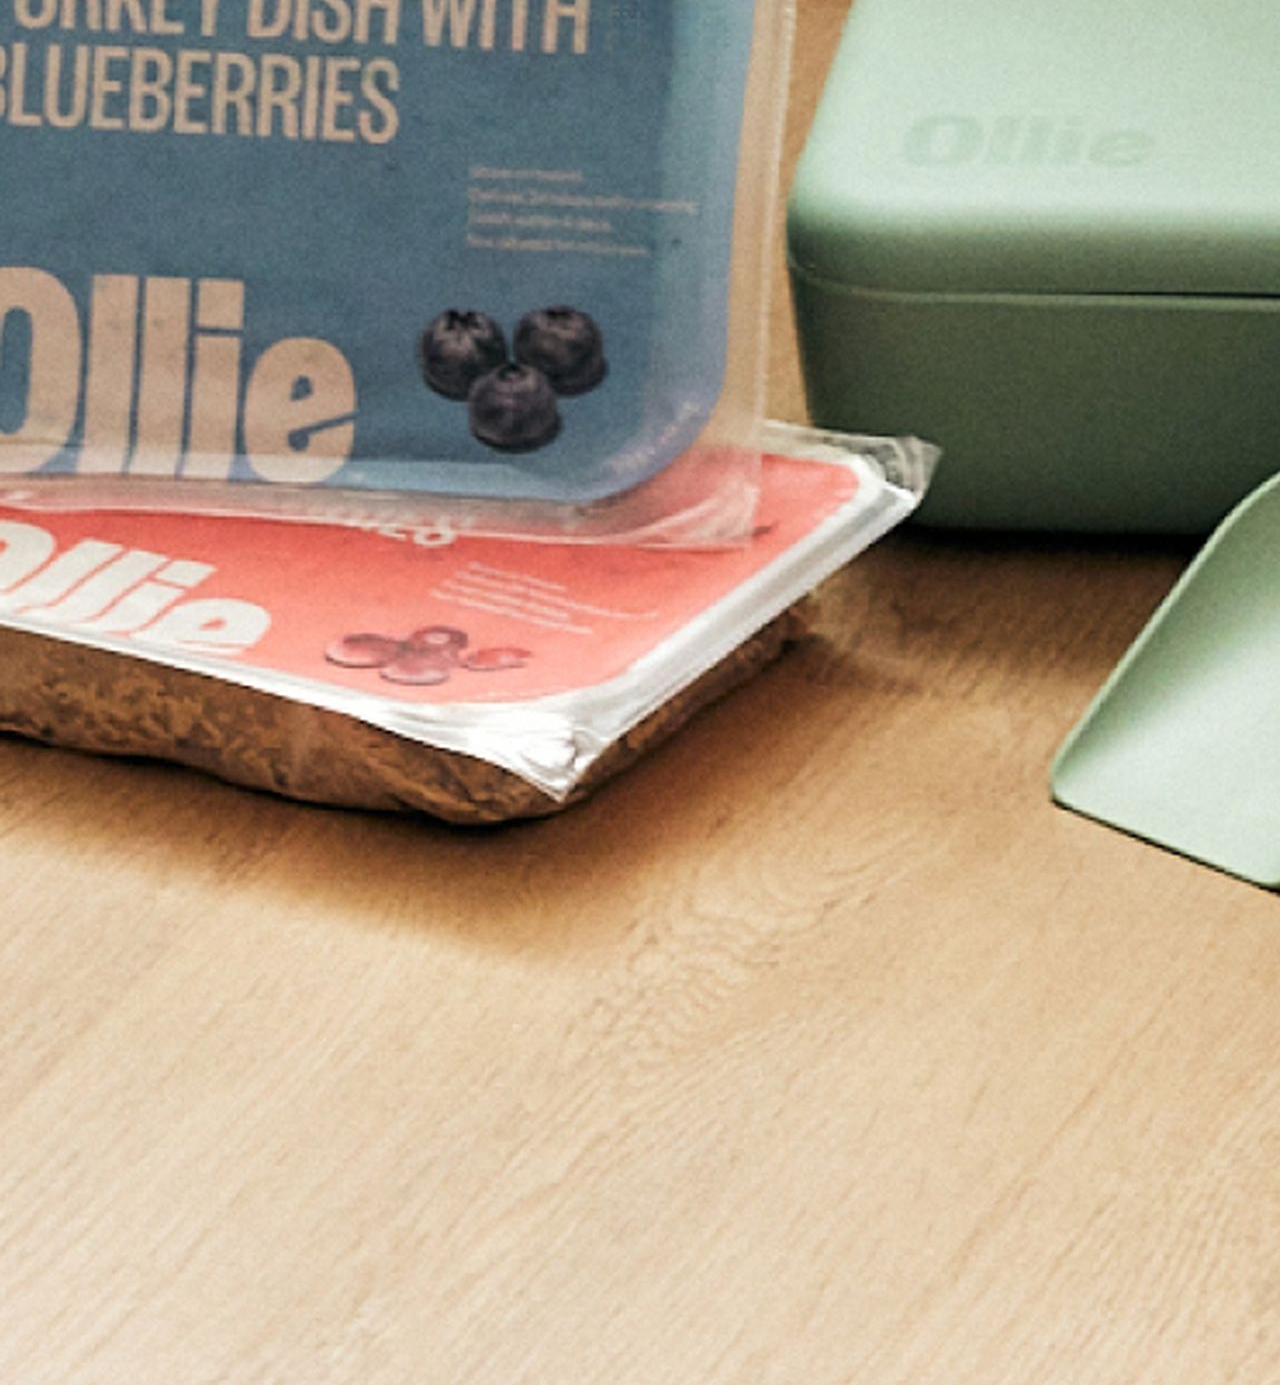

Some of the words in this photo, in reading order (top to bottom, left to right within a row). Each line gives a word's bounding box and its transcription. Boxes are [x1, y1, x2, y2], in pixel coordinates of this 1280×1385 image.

[0, 42, 400, 145] LUEBERRIES
[903, 112, 1155, 167] Ollie
[0, 266, 358, 483] Ollie
